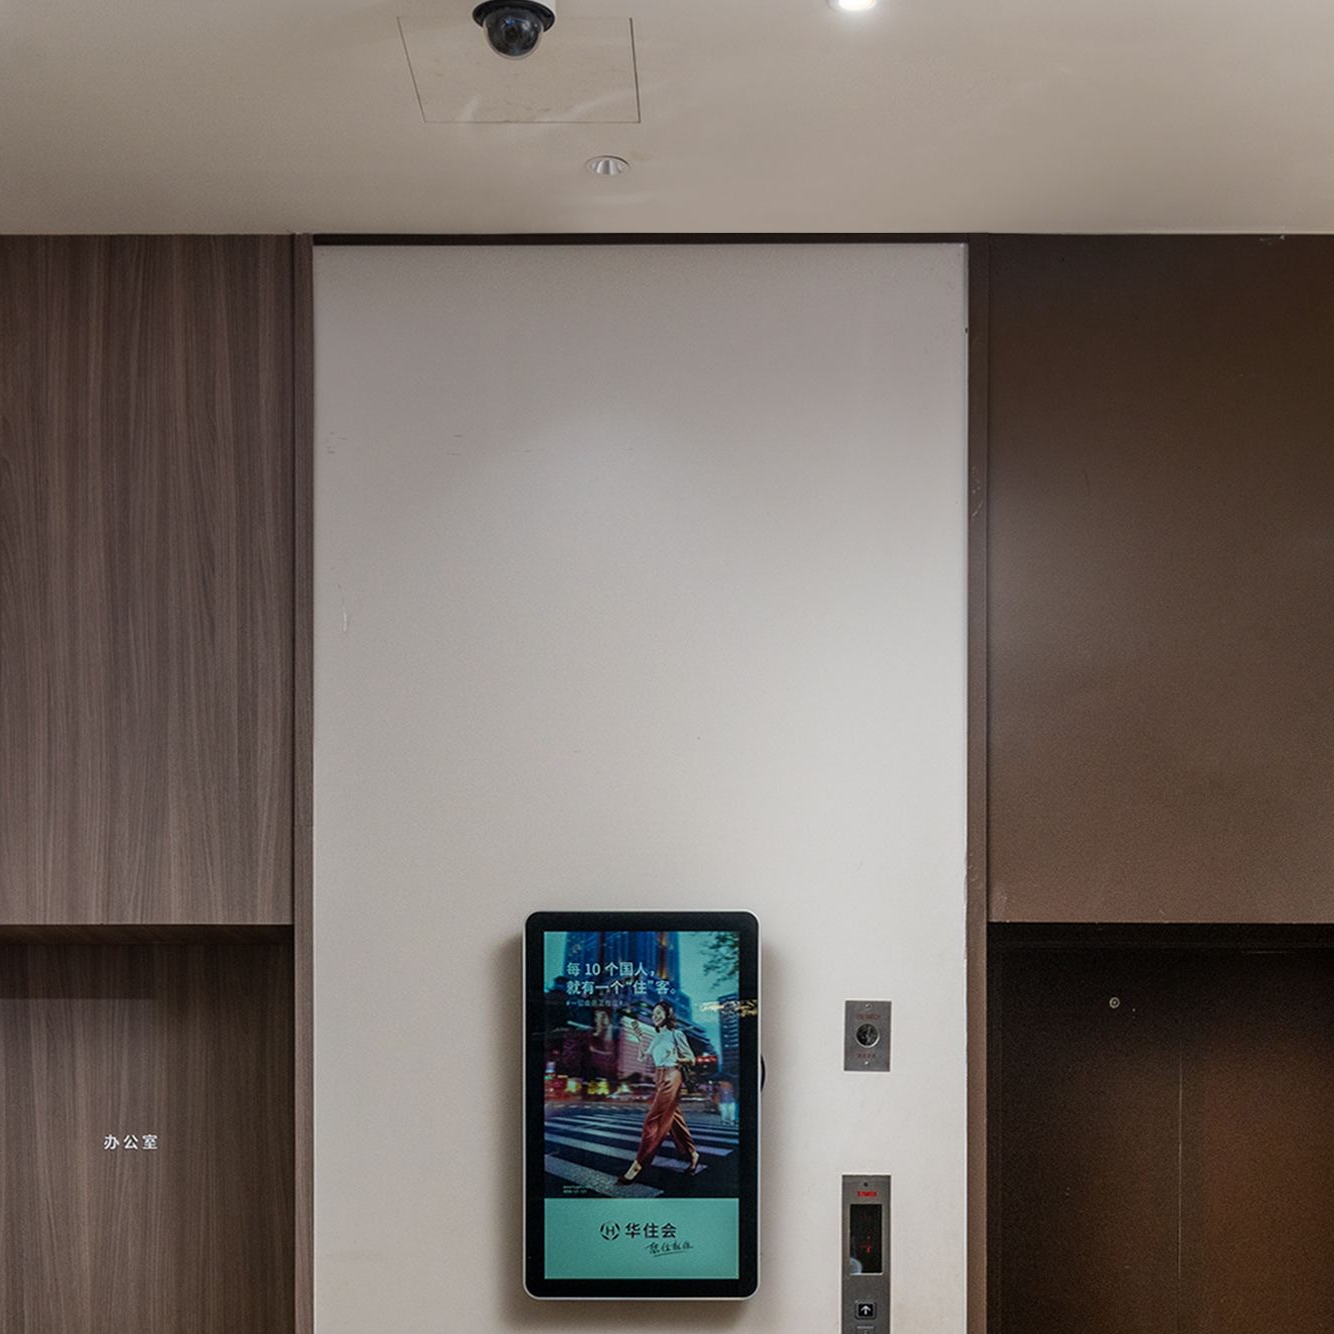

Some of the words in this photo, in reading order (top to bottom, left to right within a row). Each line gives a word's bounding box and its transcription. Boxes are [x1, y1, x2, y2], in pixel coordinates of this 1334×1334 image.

[566, 961, 581, 977] 每
[584, 962, 602, 977] 10
[103, 1133, 159, 1150] 办公室
[625, 1222, 678, 1239] 华住会
